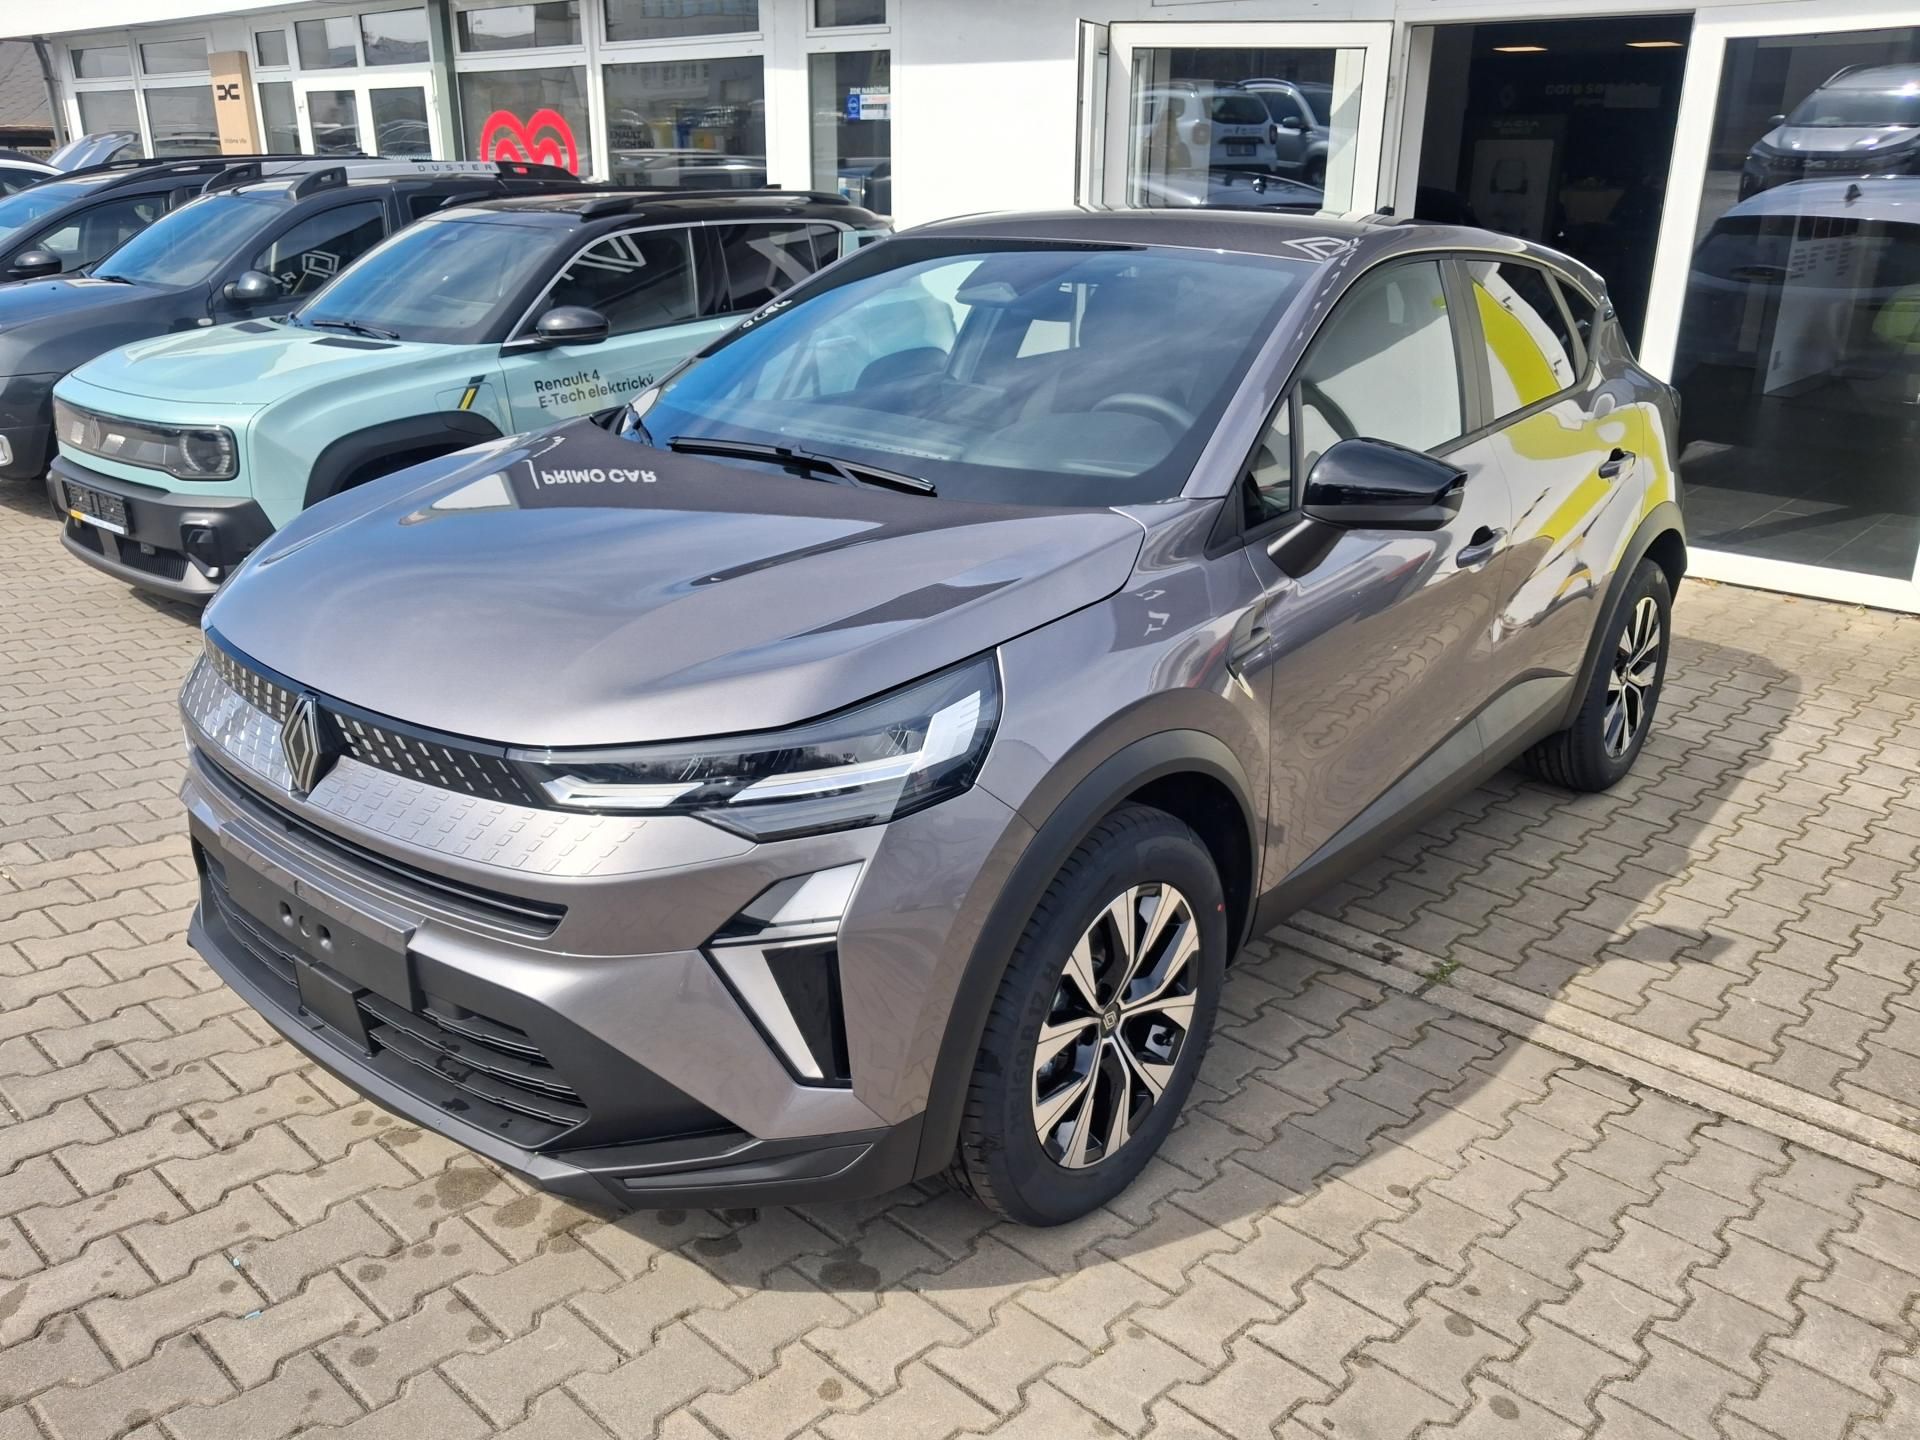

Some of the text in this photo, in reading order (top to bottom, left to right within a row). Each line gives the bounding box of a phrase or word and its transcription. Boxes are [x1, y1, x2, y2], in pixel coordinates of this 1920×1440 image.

[416, 163, 494, 173] DUSTER
[534, 369, 601, 393] Renault 4
[538, 387, 586, 409] E-Tech
